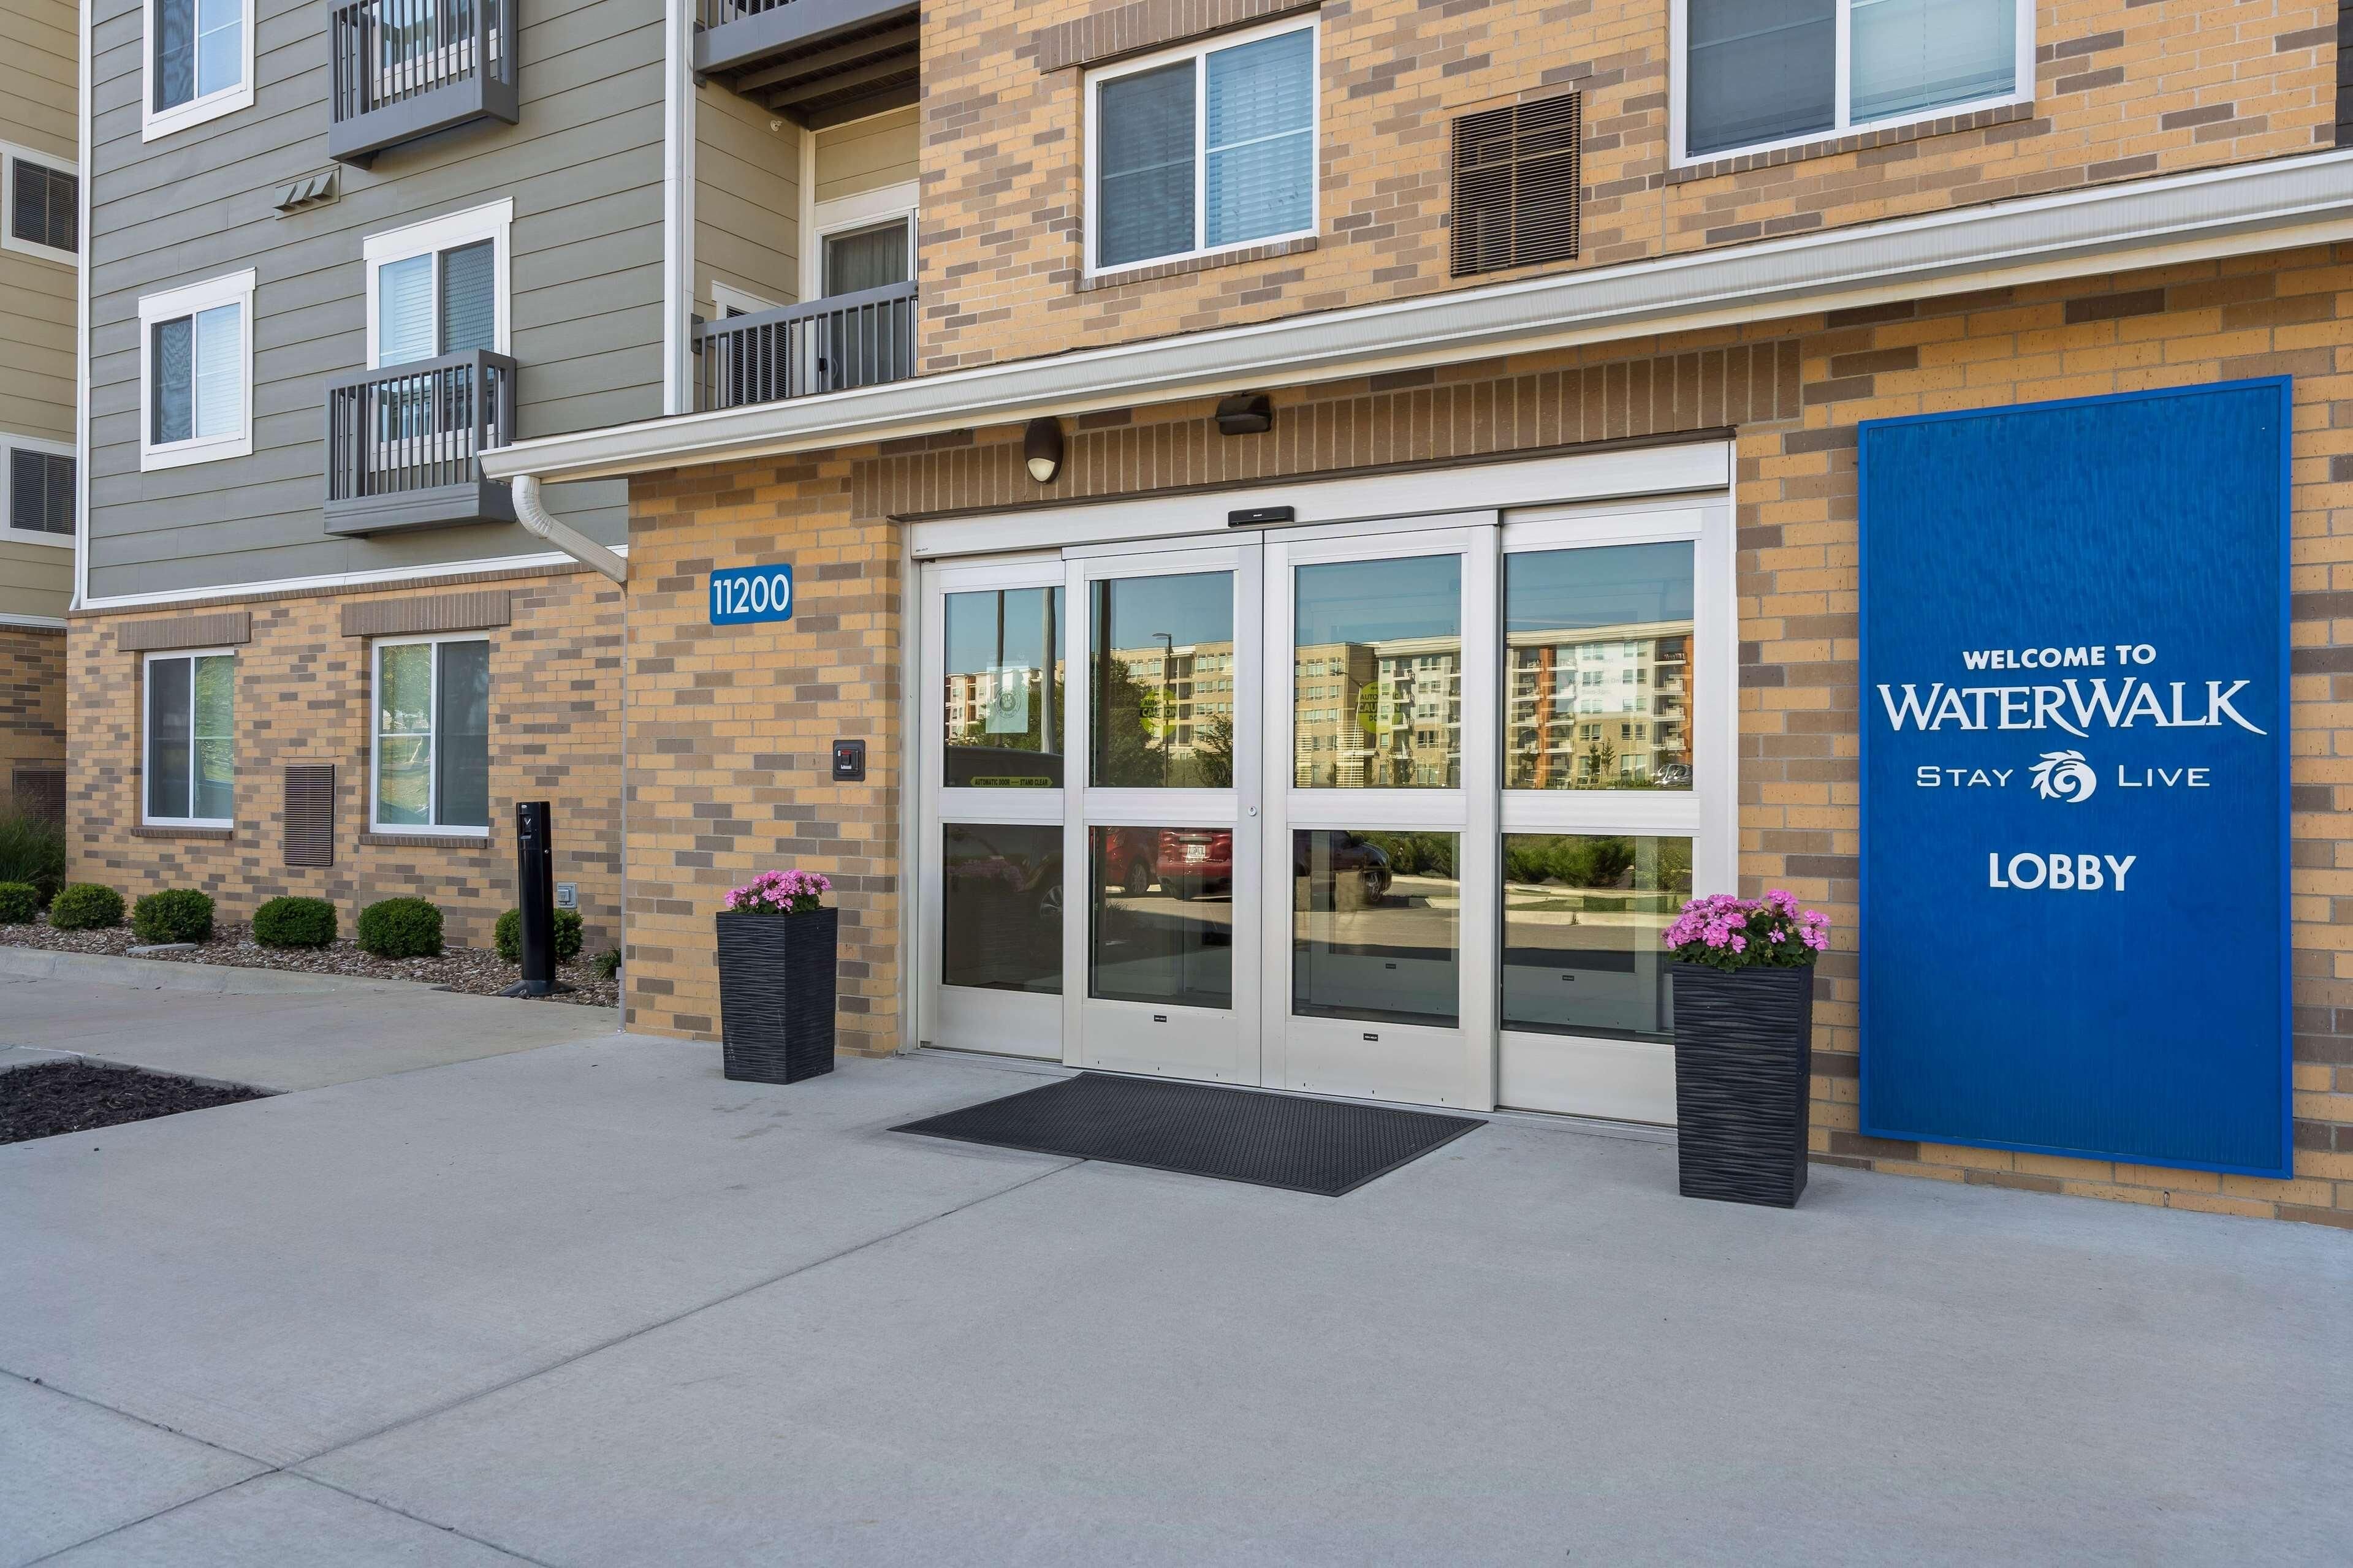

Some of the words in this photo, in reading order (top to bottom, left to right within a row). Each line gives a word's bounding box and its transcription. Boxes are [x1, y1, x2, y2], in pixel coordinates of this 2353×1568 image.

[713, 574, 790, 615] 11200
[1963, 646, 2106, 670] WELCOME
[2115, 644, 2157, 665] TO
[1142, 707, 1177, 718] CAON
[1877, 677, 2268, 738] WATERWALK
[1917, 766, 2015, 787] STAY
[2119, 764, 2211, 788] LIVE
[1990, 852, 2137, 892] LOBBY
